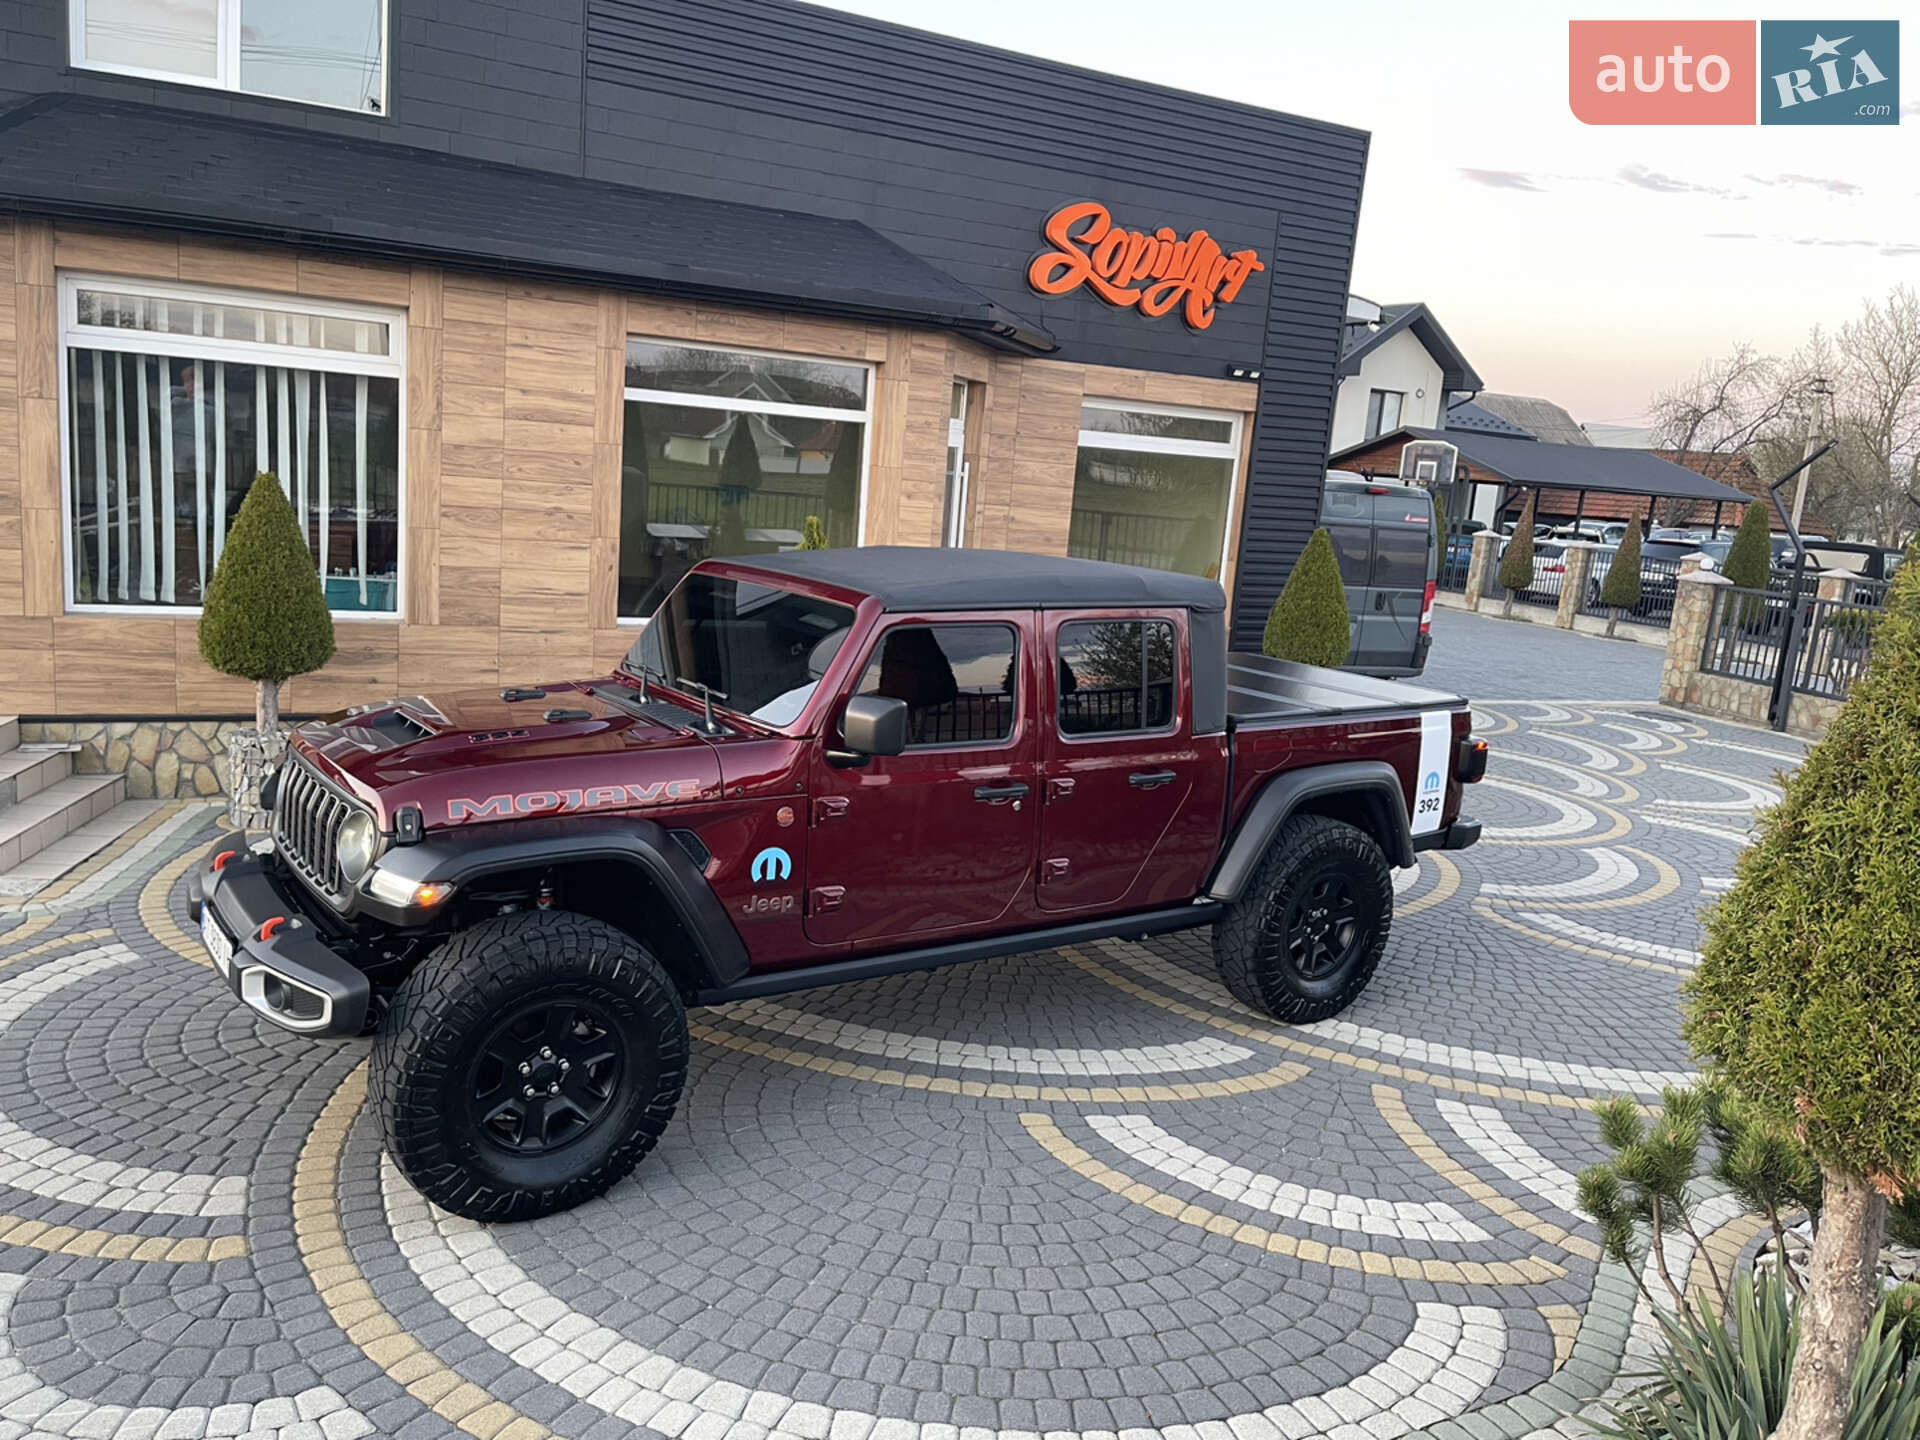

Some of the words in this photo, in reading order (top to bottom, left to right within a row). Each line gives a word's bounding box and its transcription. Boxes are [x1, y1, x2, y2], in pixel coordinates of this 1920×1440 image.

[447, 779, 701, 819] MOJAVE
[1418, 797, 1440, 814] 392
[742, 895, 795, 914] Jeep
